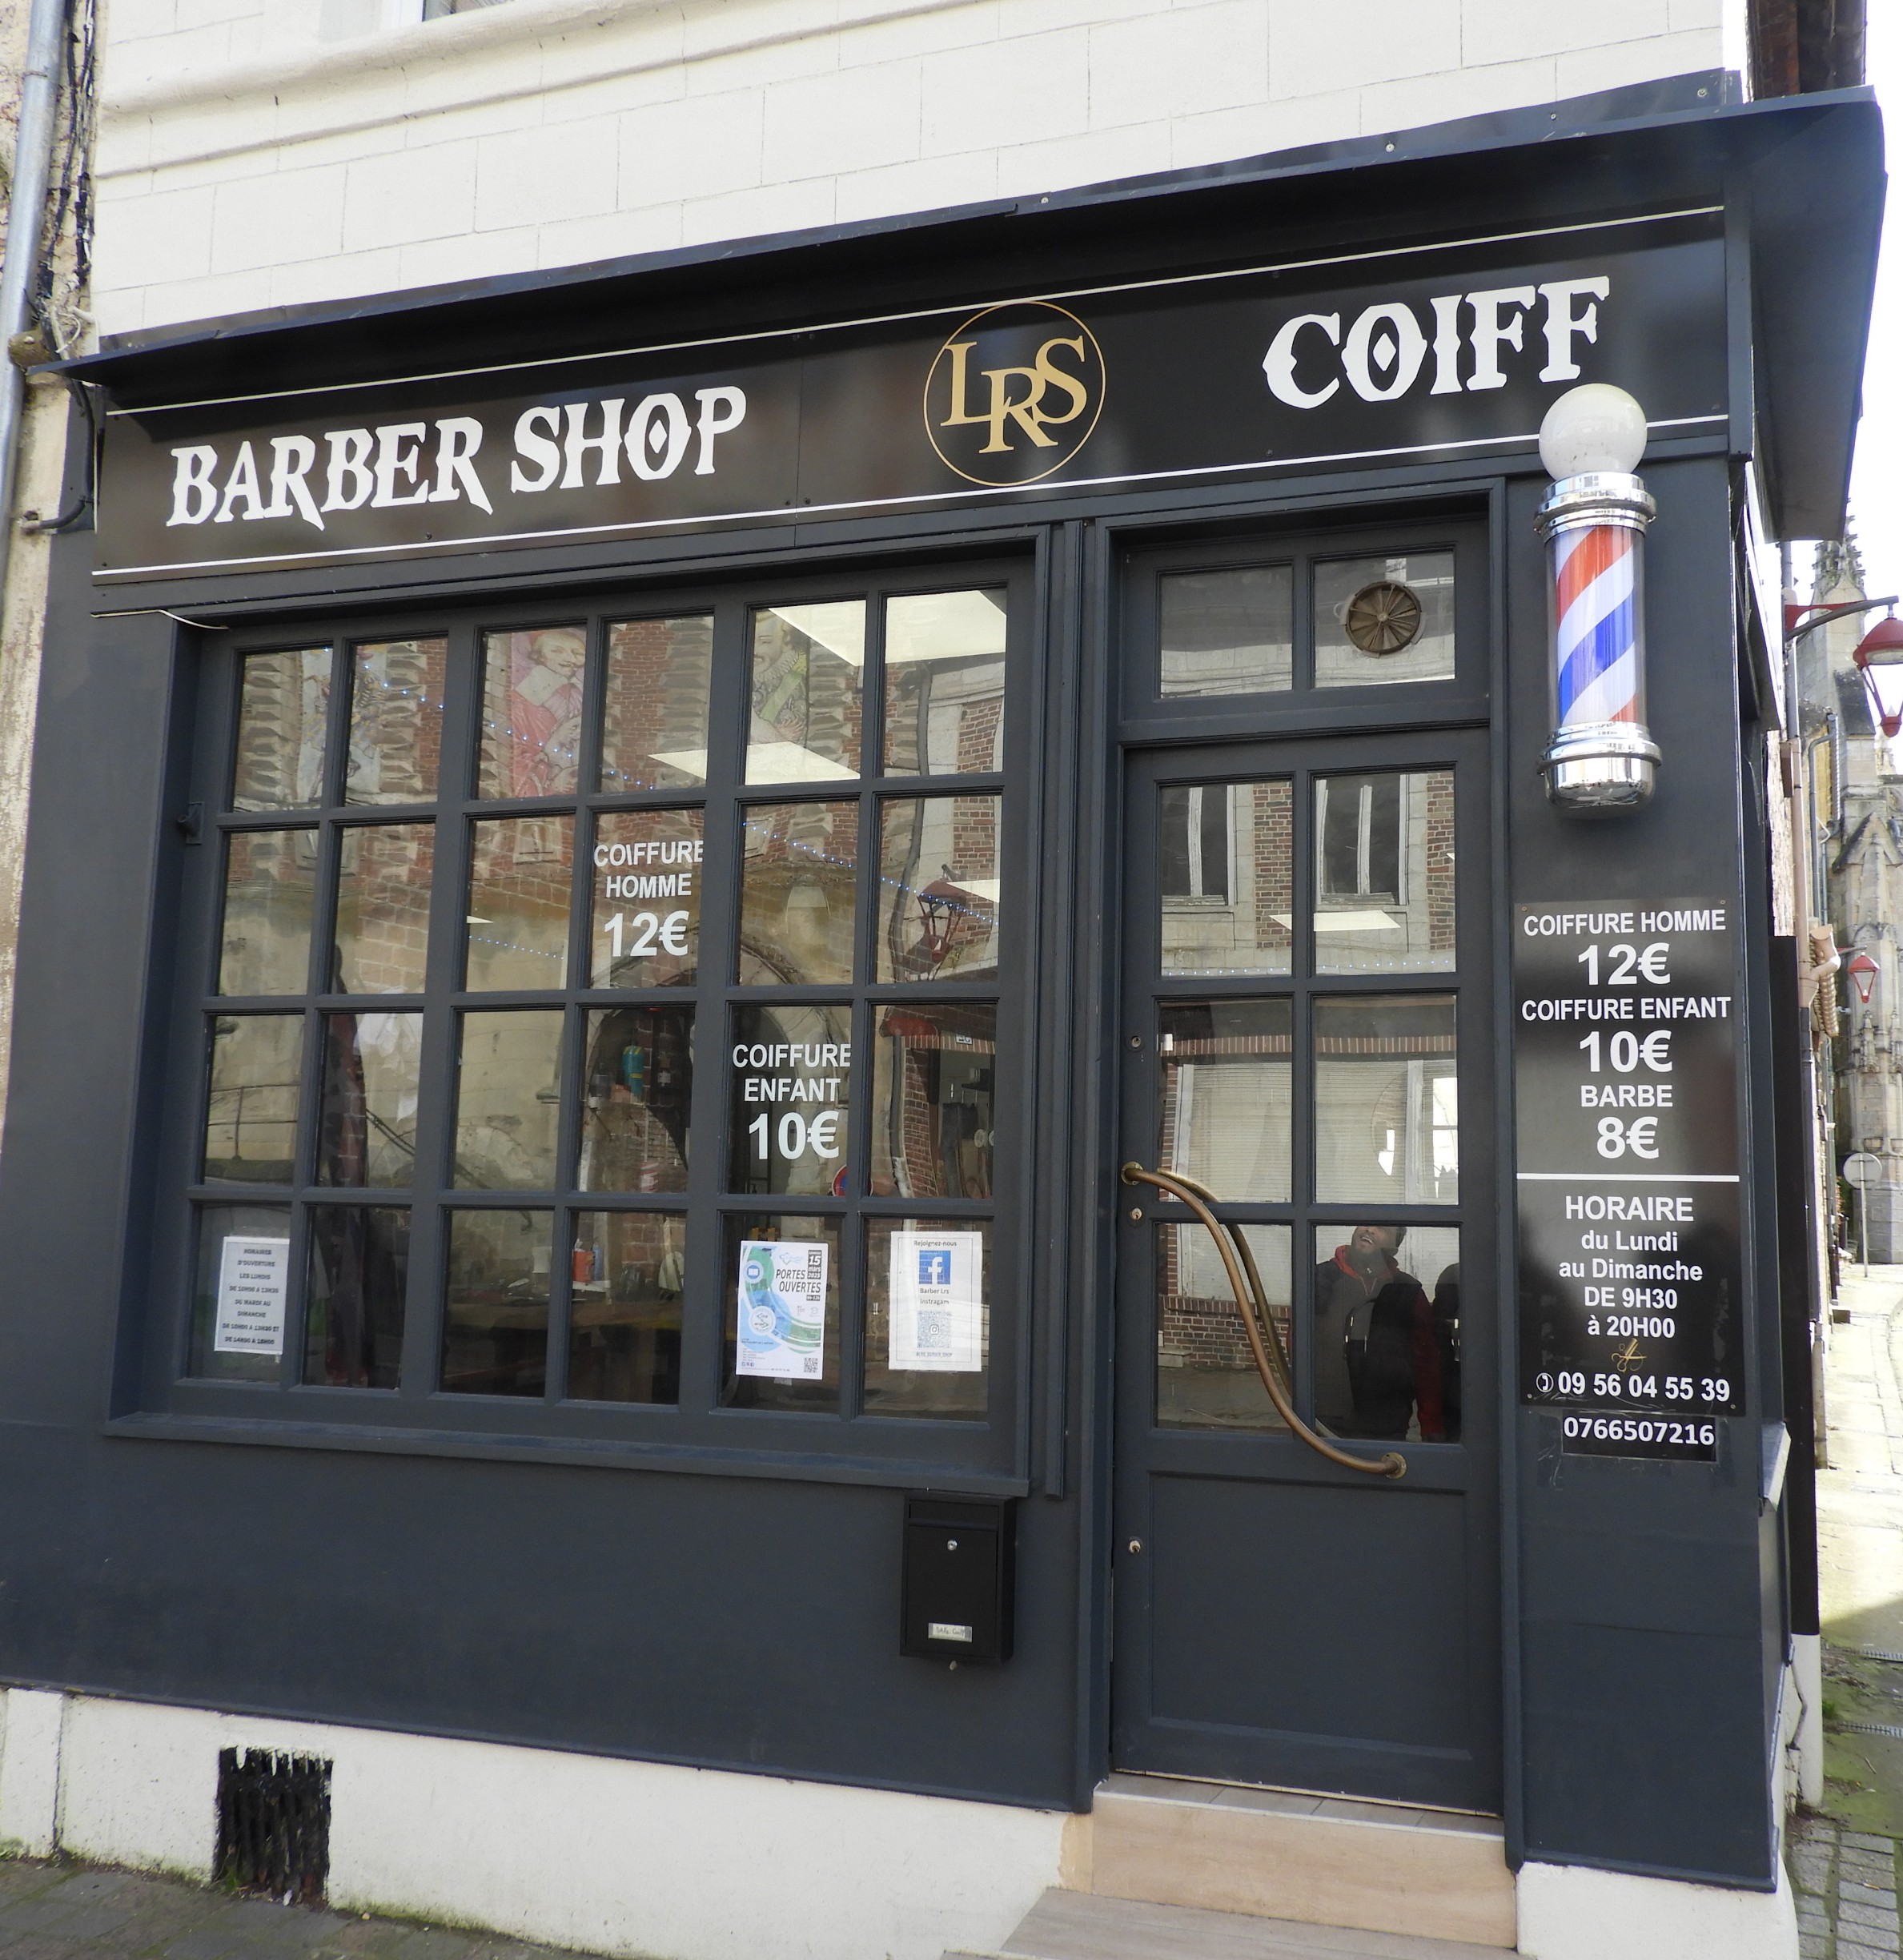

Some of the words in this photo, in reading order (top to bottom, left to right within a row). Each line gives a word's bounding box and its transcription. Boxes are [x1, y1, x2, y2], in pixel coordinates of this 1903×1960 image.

[1263, 275, 1610, 409] COIFF
[941, 335, 1087, 454] LRS
[166, 416, 493, 531] BARBER
[511, 386, 746, 493] SHOP
[593, 841, 704, 867] COIFFURE
[606, 873, 693, 898] HOMME
[604, 910, 689, 957] 12€
[1524, 913, 1634, 936] COIFFURE
[1640, 910, 1726, 932] HOMME
[1578, 942, 1671, 985] 12€
[1521, 999, 1634, 1021] COIFFURE
[1640, 997, 1731, 1019] ENFANT
[733, 1043, 852, 1067] COIFFURE
[1579, 1030, 1672, 1073] 10€
[744, 1078, 841, 1102] ENFANT
[1580, 1085, 1673, 1107] BARBE
[749, 1111, 839, 1160] 10€
[1596, 1116, 1660, 1159] 8€
[1565, 1195, 1694, 1222] HORAIRE
[913, 1239, 958, 1247] Rejoignez-nous
[1581, 1230, 1608, 1250] du
[1616, 1231, 1678, 1252] Lundi
[809, 1255, 821, 1266] 15
[1559, 1260, 1585, 1278] au
[1592, 1258, 1703, 1281] Dimanche
[776, 1268, 806, 1279] PORTES
[779, 1281, 821, 1293] OUVERTES
[1584, 1286, 1616, 1307] DE
[1622, 1287, 1678, 1310] 9H30
[1587, 1314, 1600, 1335] à
[1606, 1315, 1676, 1339] 20H00
[1558, 1372, 1586, 1395] 09
[1592, 1373, 1622, 1397] 56
[1628, 1375, 1657, 1398] 04
[1664, 1376, 1694, 1400] 55
[1700, 1379, 1731, 1402] 39
[1564, 1416, 1716, 1446] 0766507216
